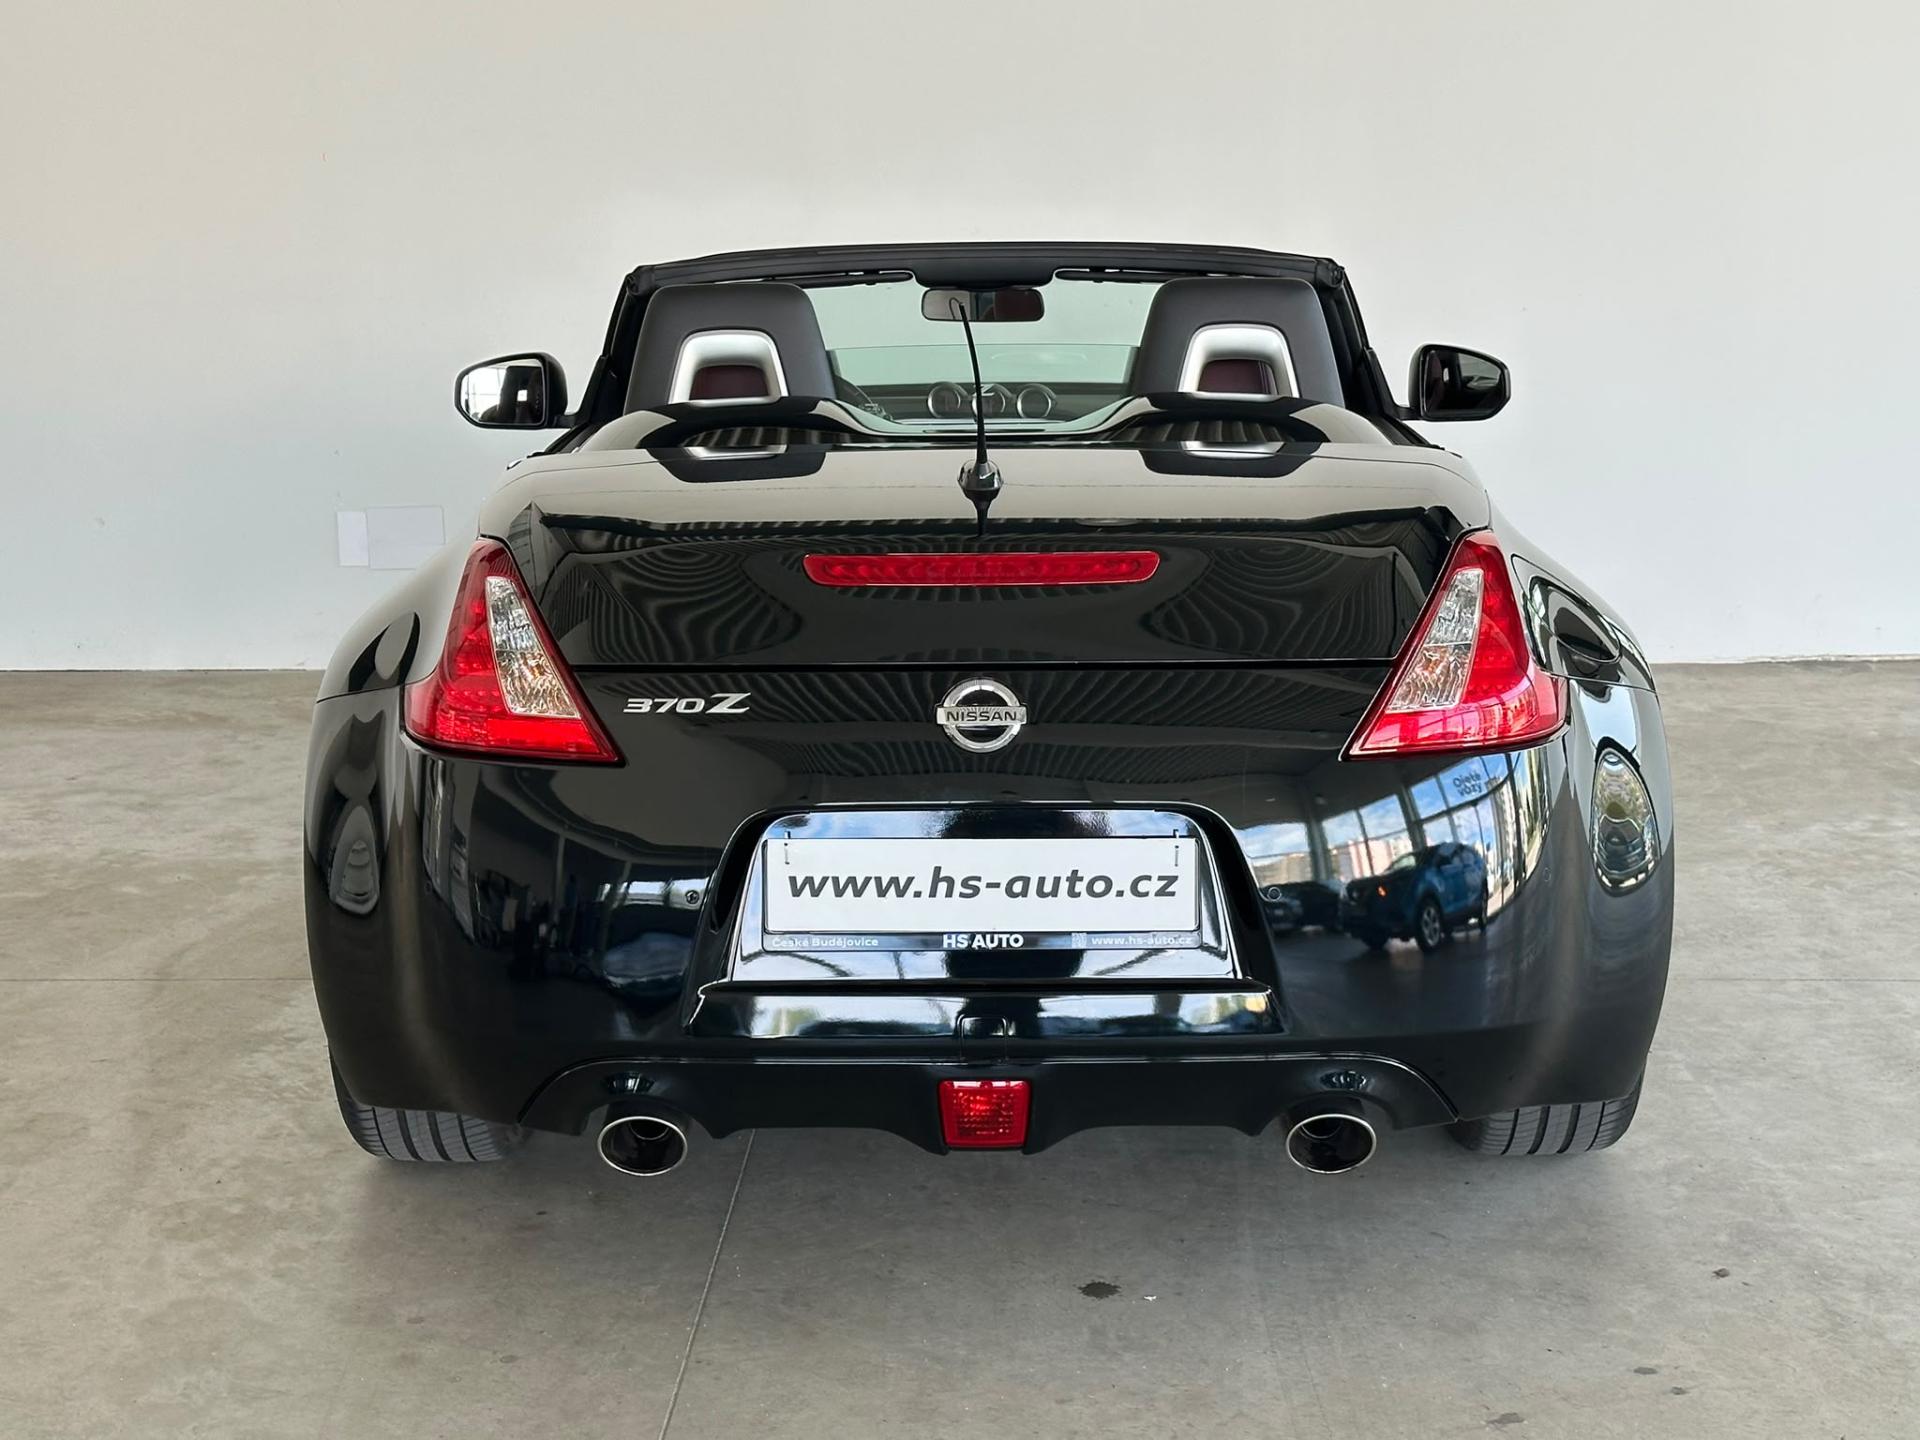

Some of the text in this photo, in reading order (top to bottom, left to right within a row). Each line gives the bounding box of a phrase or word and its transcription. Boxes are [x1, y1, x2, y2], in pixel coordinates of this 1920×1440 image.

[623, 692, 751, 714] 370Z
[946, 711, 1017, 722] NISSAN
[788, 865, 1179, 899] www.hs-auto.cz
[772, 934, 880, 949] České Budějovice
[942, 933, 1024, 949] HS AUTO
[1091, 934, 1193, 946] www.hs-auto.cz
